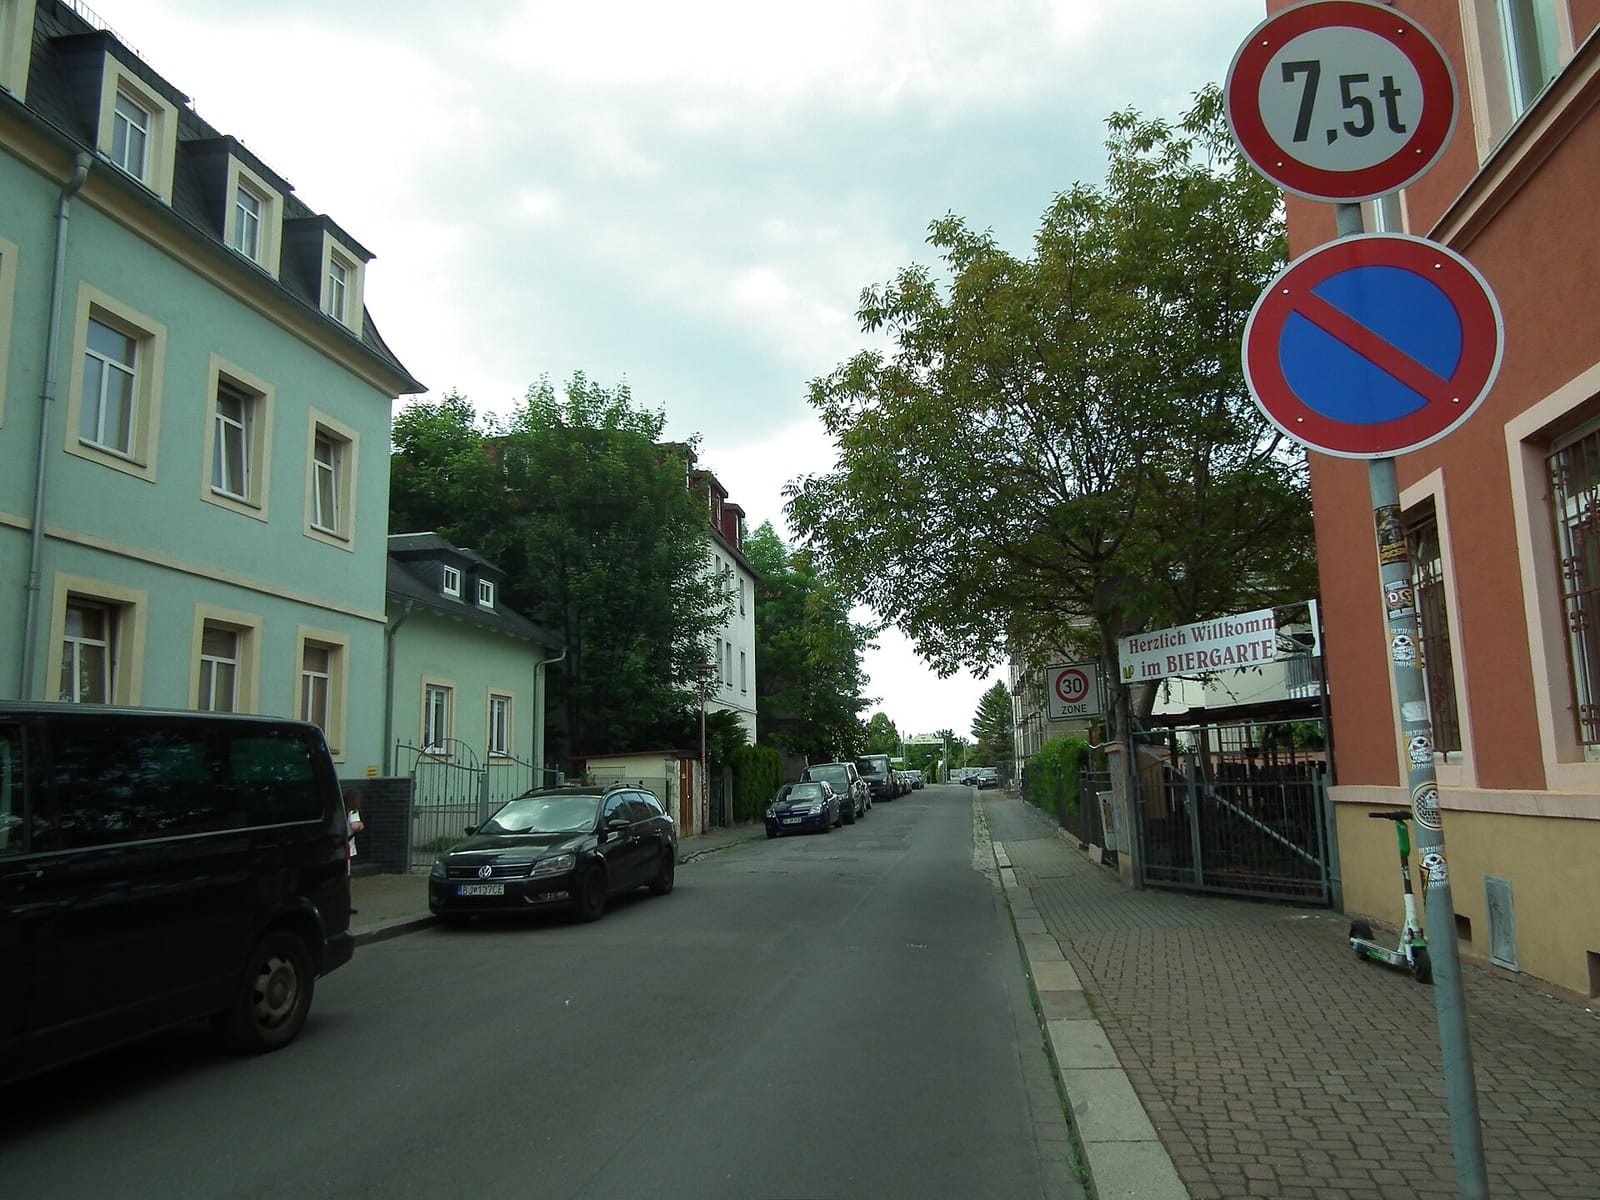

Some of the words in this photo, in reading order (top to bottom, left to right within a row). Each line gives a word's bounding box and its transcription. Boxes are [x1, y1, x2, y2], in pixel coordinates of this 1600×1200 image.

[1281, 60, 1406, 146] 7,5t
[1128, 630, 1187, 655] Herzlich
[1191, 617, 1275, 643] Willkomm
[1141, 661, 1161, 677] im
[1166, 639, 1273, 673] BIERGARTE
[1062, 677, 1082, 694] 30
[1061, 704, 1087, 715] ZONE
